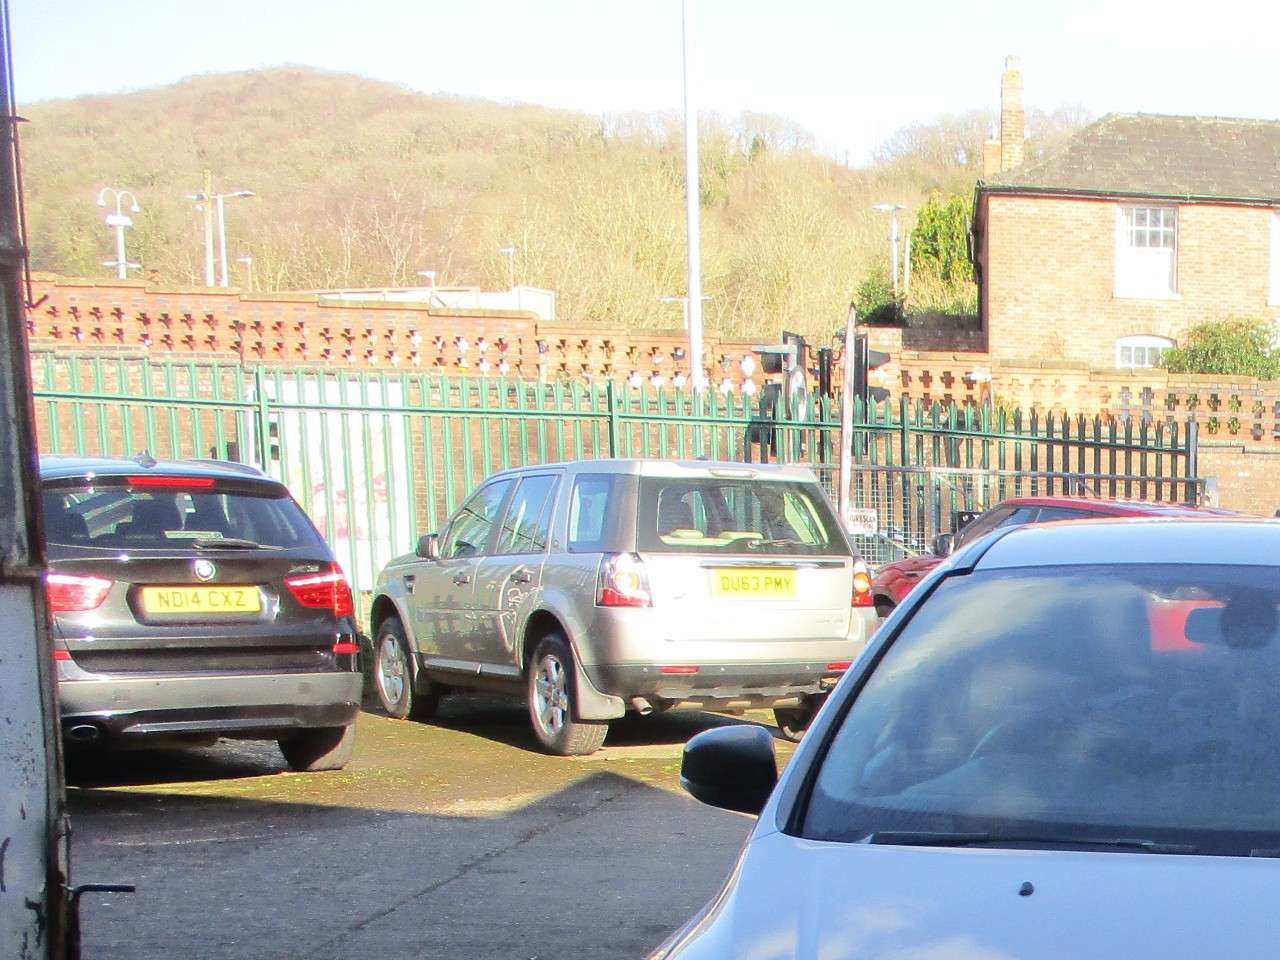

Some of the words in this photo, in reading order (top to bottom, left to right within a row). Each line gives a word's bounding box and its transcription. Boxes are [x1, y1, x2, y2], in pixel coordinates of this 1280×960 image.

[764, 575, 792, 591] PMY
[157, 591, 201, 608] ND14
[208, 590, 246, 607] CXZ
